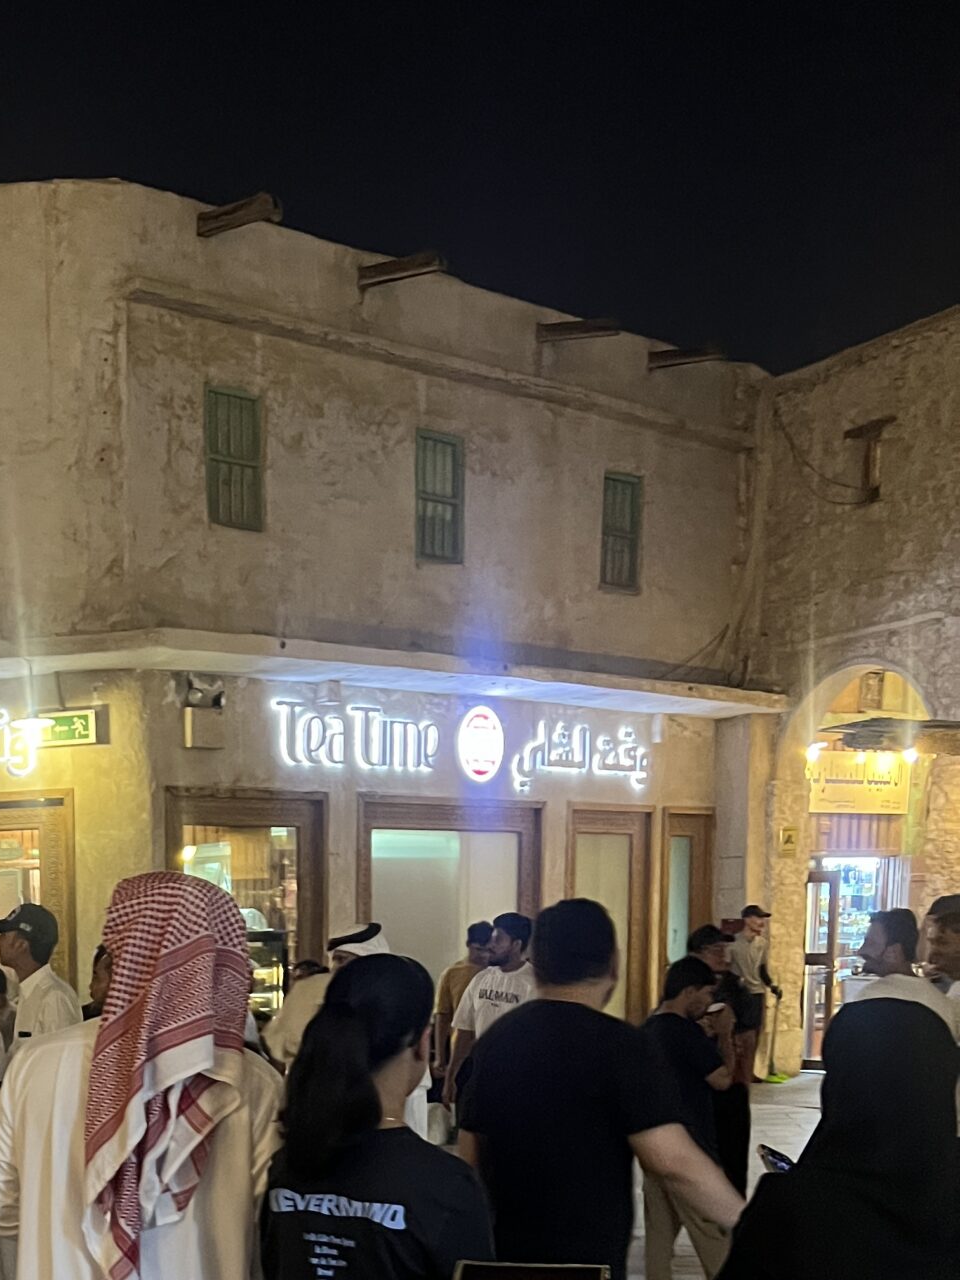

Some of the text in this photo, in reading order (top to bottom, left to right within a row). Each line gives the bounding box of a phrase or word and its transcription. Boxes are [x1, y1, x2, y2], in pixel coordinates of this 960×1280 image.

[273, 699, 440, 772] Tea Time
[512, 719, 650, 794] وقت الشاي
